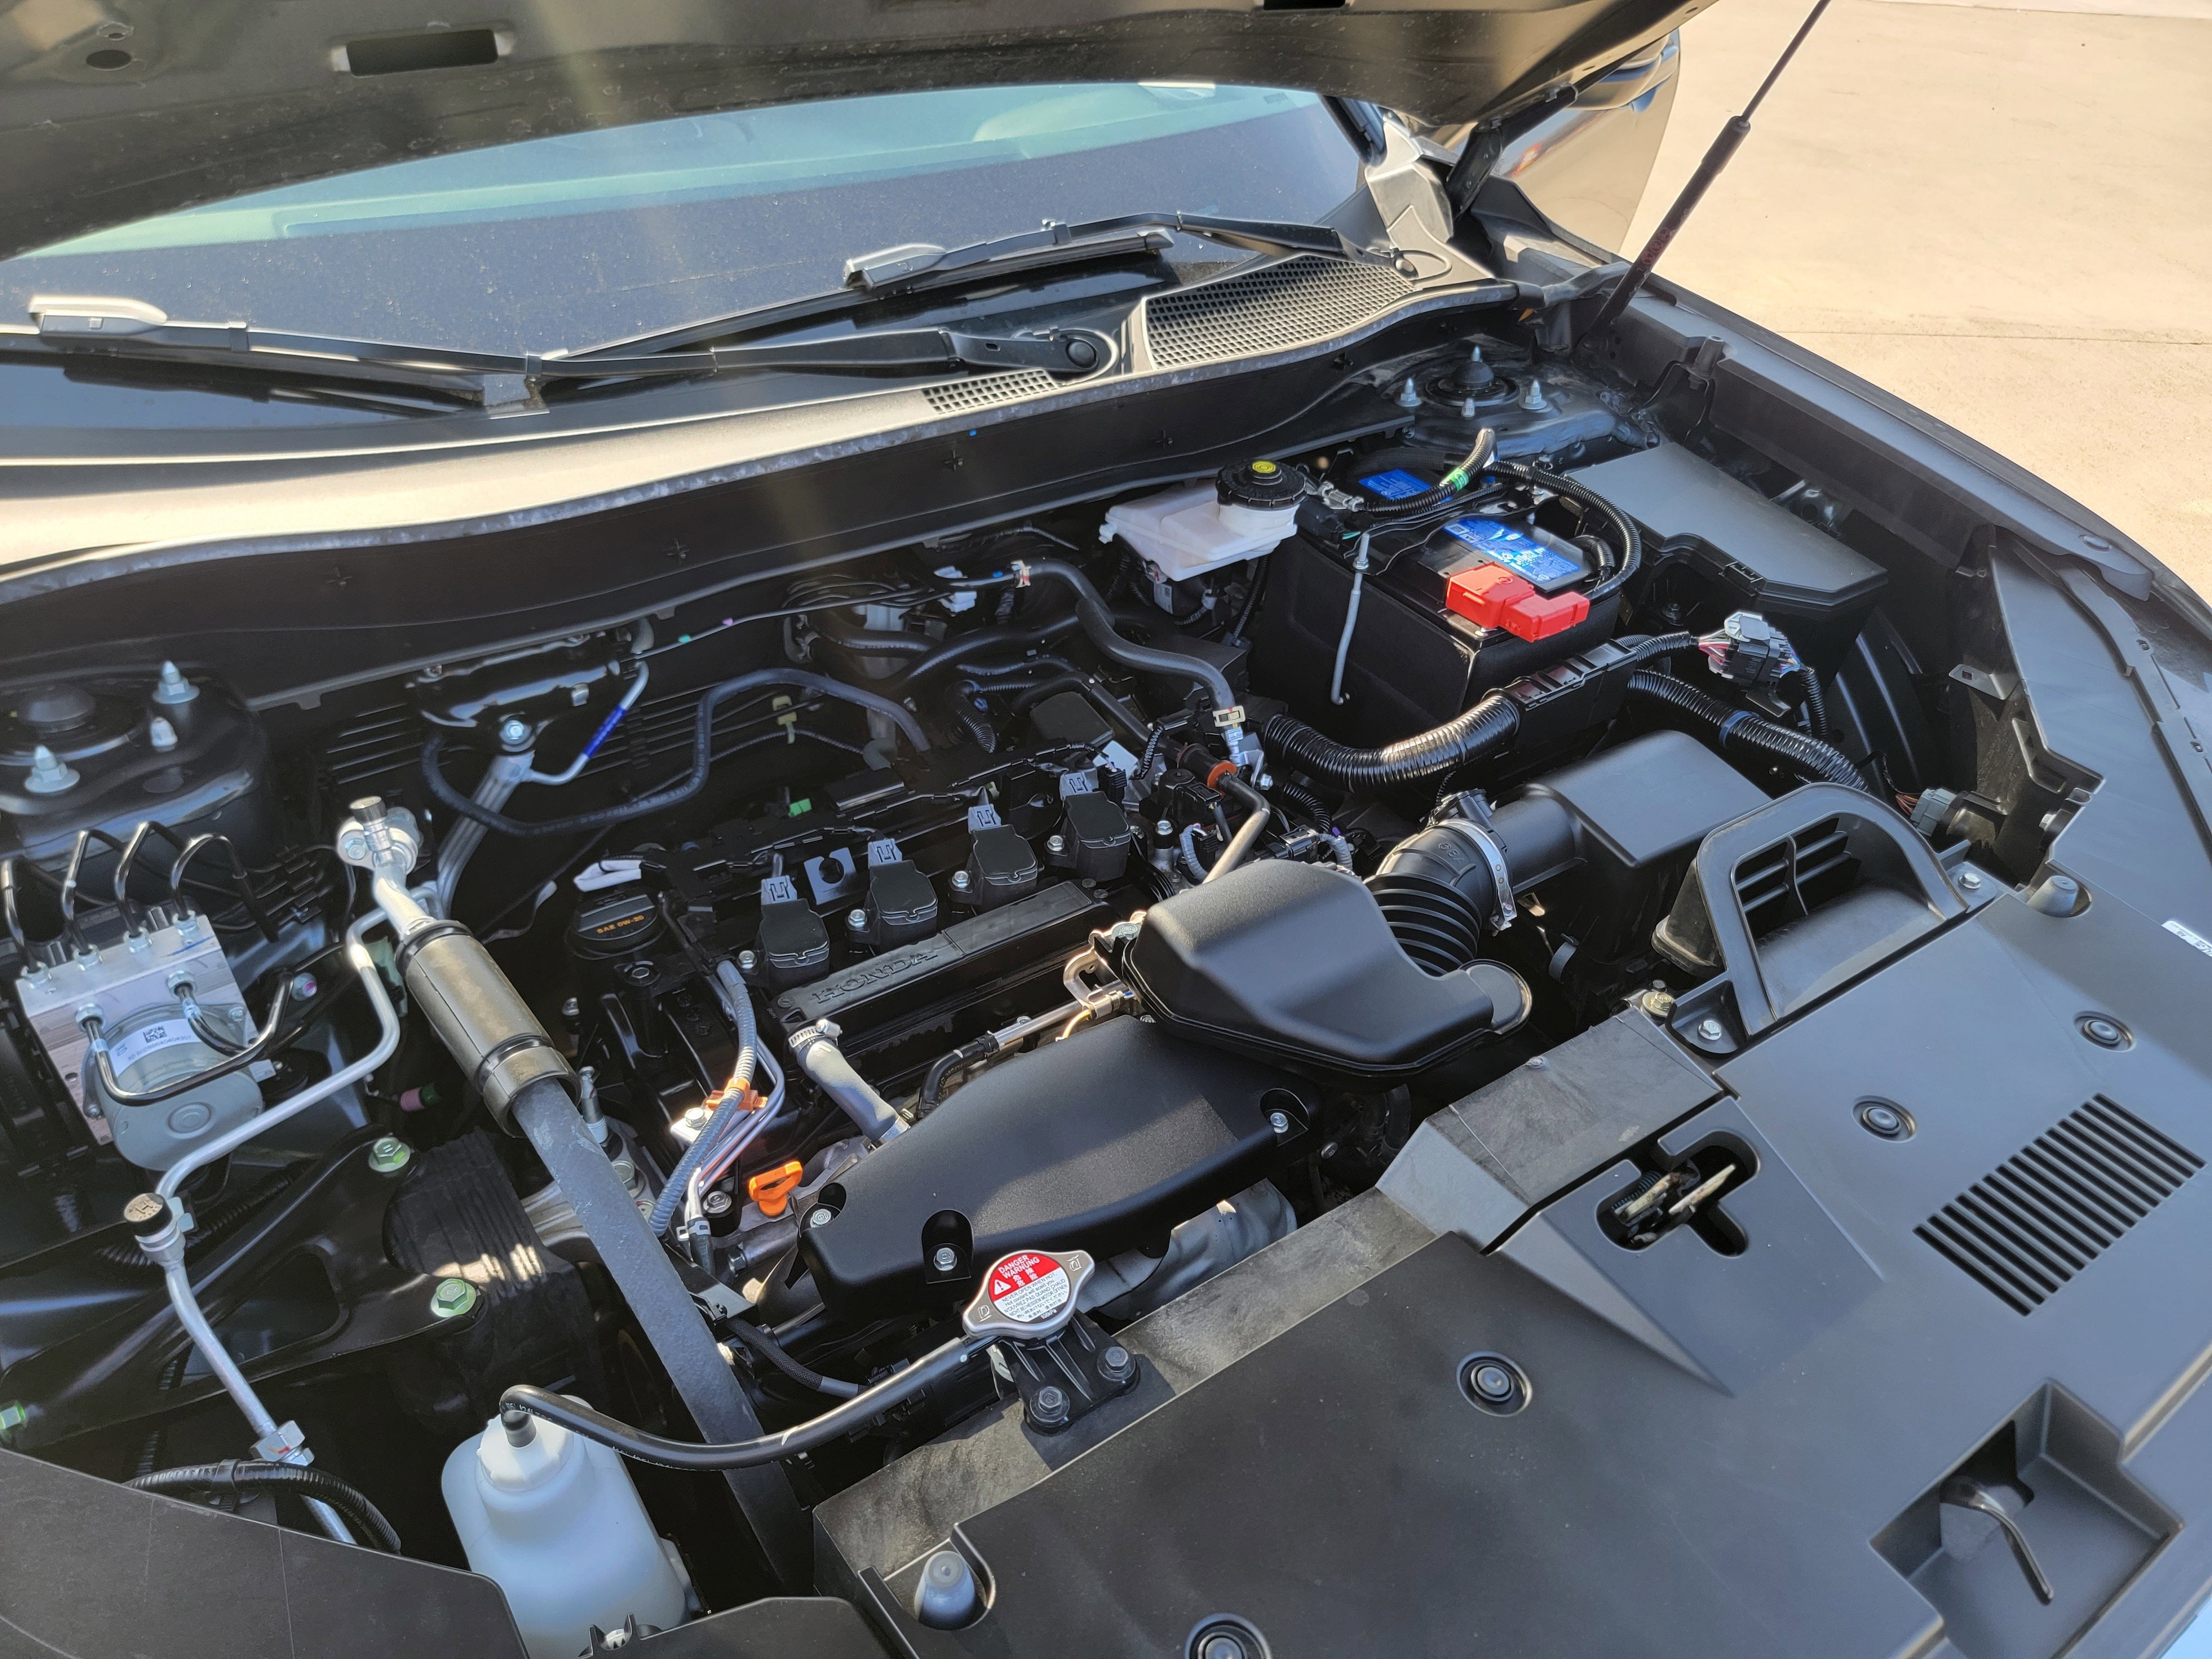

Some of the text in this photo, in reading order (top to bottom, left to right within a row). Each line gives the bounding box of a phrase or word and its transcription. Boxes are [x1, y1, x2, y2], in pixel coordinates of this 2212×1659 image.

[597, 915, 644, 933] SAE 0W-20
[810, 952, 938, 1004] HONDA
[998, 1255, 1029, 1273] DANGER
[1002, 1257, 1040, 1279] WARNUNG
[1002, 1291, 1019, 1302] NEVER
[1018, 1285, 1032, 1295] OPEN
[1032, 1278, 1046, 1287] WHEN
[1013, 1292, 1029, 1303] coolant
[1026, 1295, 1036, 1303] PAS
[1036, 1287, 1051, 1299] QUAND
[1050, 1278, 1066, 1291] CHAUD
[1040, 1291, 1053, 1301] MOTOR
